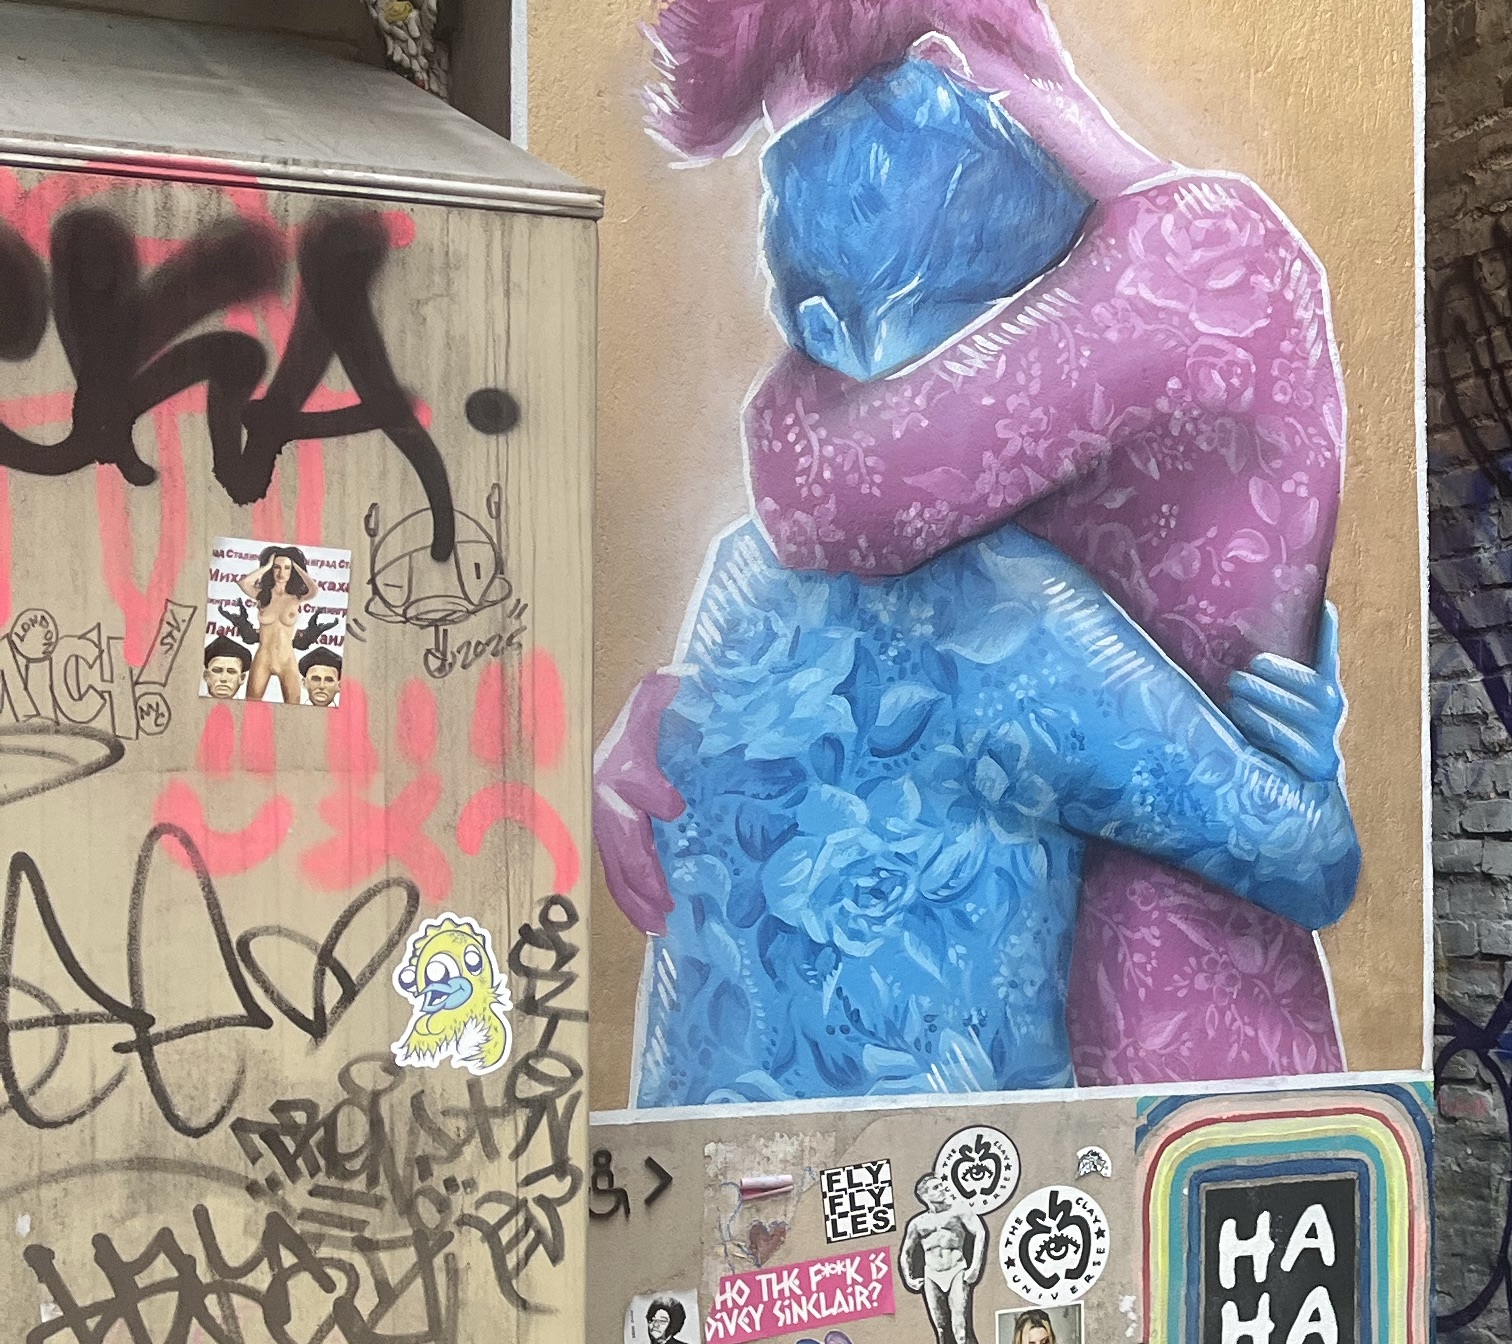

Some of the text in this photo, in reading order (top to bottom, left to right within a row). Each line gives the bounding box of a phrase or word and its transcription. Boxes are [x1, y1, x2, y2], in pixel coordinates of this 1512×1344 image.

[826, 1161, 888, 1193] FLY
[828, 1185, 886, 1216] FLY
[830, 1208, 891, 1240] LES
[1004, 1196, 1102, 1249] THE CLAY
[1218, 1203, 1336, 1290] HA
